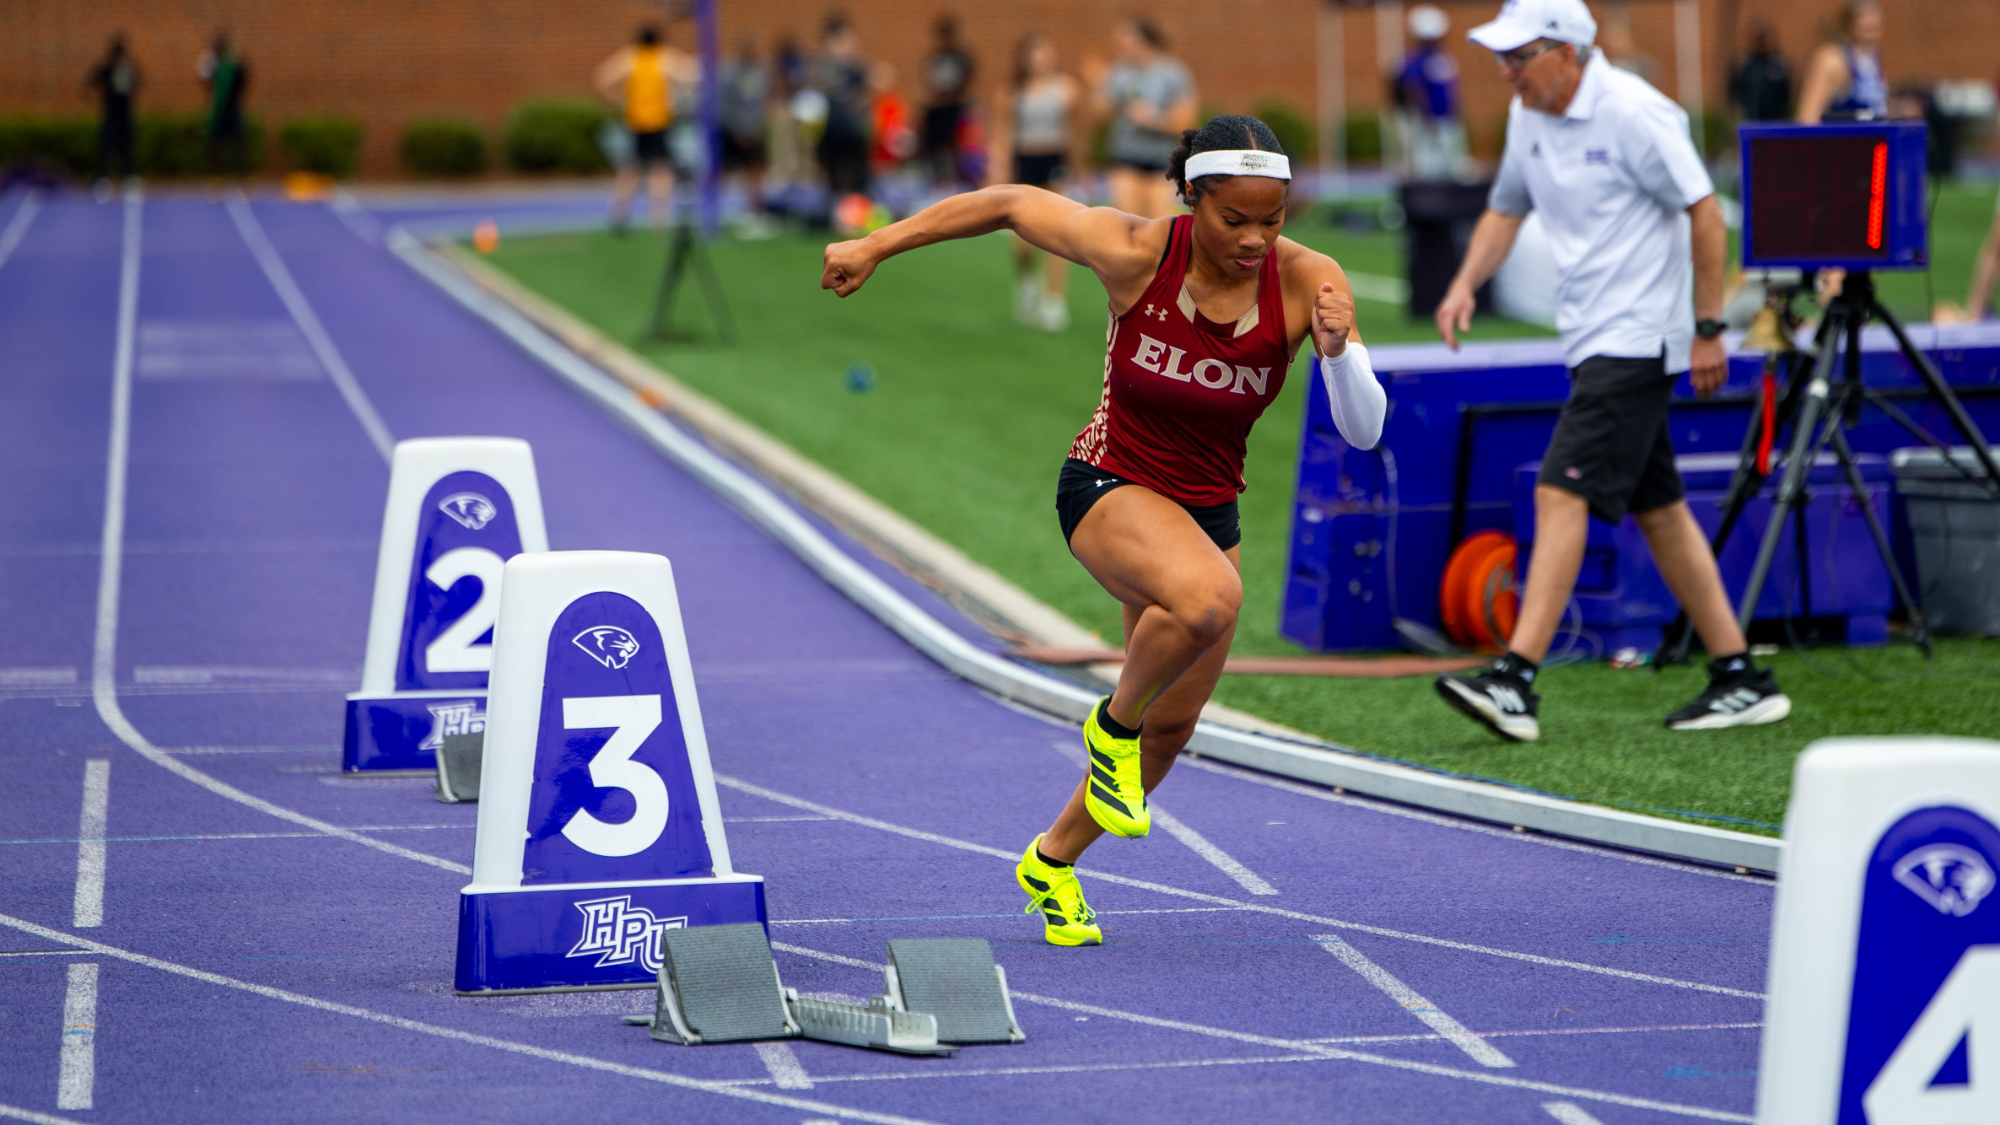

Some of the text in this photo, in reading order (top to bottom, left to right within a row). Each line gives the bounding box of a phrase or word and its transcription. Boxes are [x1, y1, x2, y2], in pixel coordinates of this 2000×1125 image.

[1867, 141, 1888, 249] 1
[1130, 332, 1272, 396] ELON
[426, 546, 505, 673] 2
[560, 694, 669, 857] 3
[1861, 943, 2000, 1125] 4
